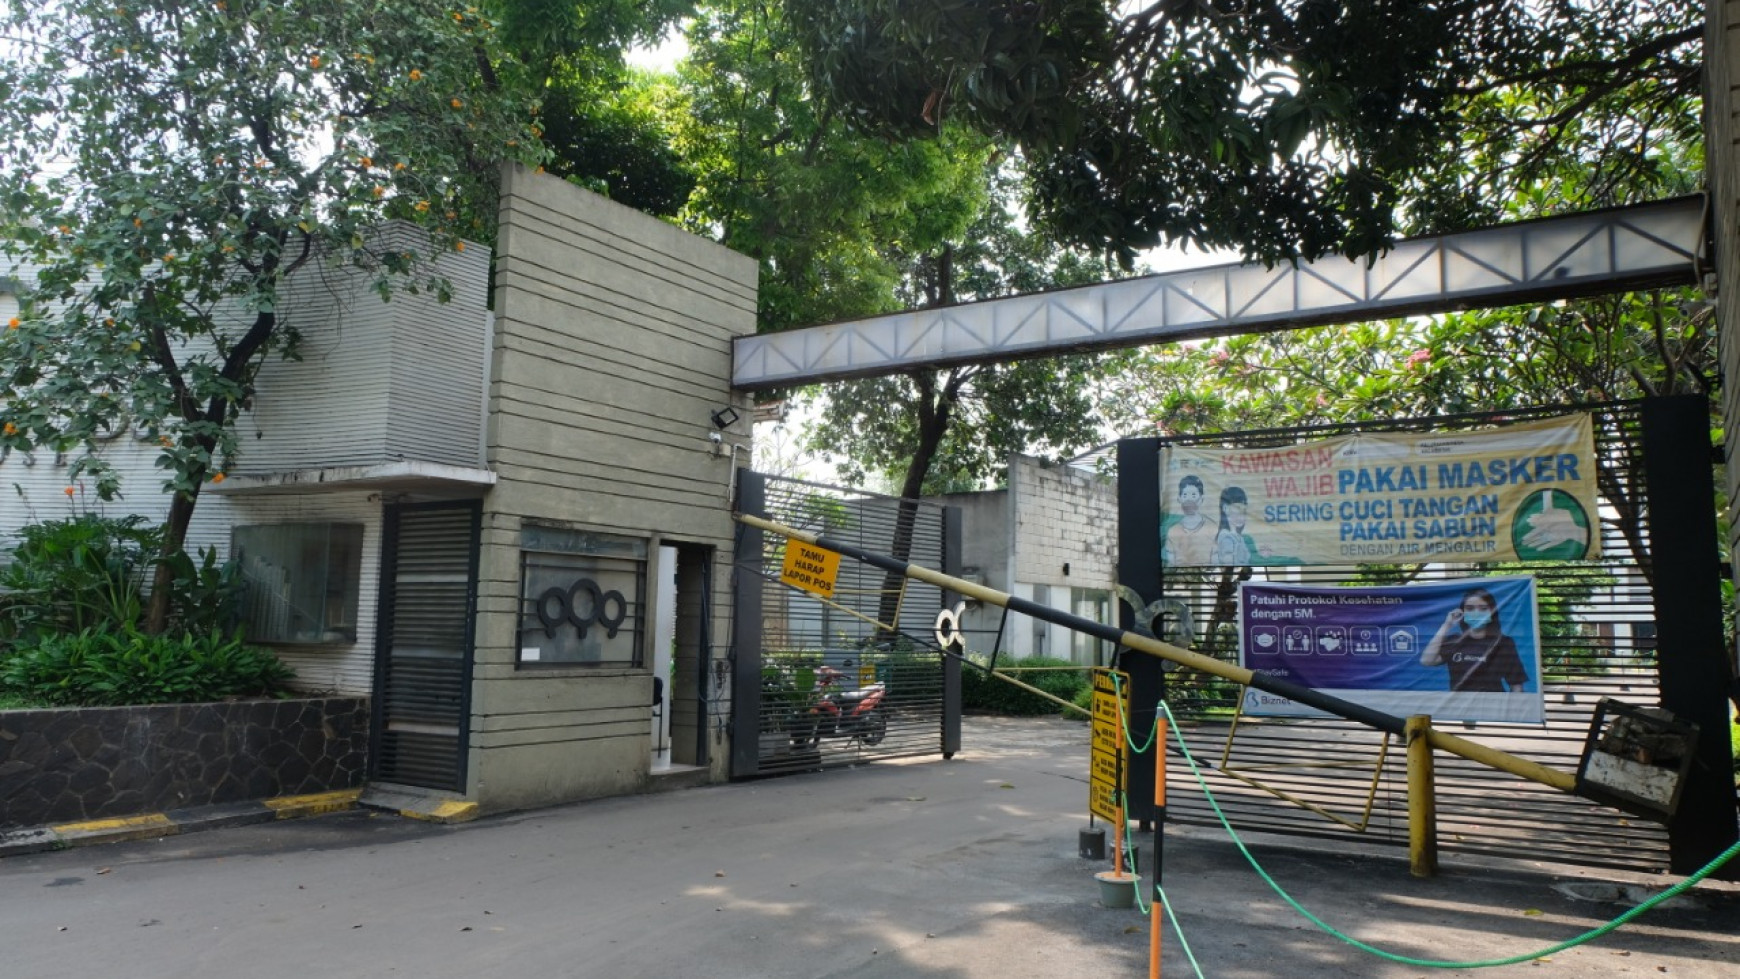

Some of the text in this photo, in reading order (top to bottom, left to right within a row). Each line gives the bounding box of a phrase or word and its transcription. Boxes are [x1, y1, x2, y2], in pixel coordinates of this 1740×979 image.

[1221, 447, 1333, 474] KAWASAN
[1338, 453, 1581, 494] PAKAI MASKER
[1264, 474, 1335, 498] WAJIB
[1264, 494, 1499, 522] SERING CUCI TANGAN
[1340, 516, 1496, 541] PAKAI SABUN
[800, 547, 825, 563] TAMU
[1341, 540, 1496, 556] DENGAN AIR MENGALIR
[794, 559, 825, 575] HARAP
[783, 568, 832, 591] LAPOR POS
[1250, 594, 1403, 605] Patuhi Protokol Kesehatan
[1251, 608, 1316, 620] dengan 5M.
